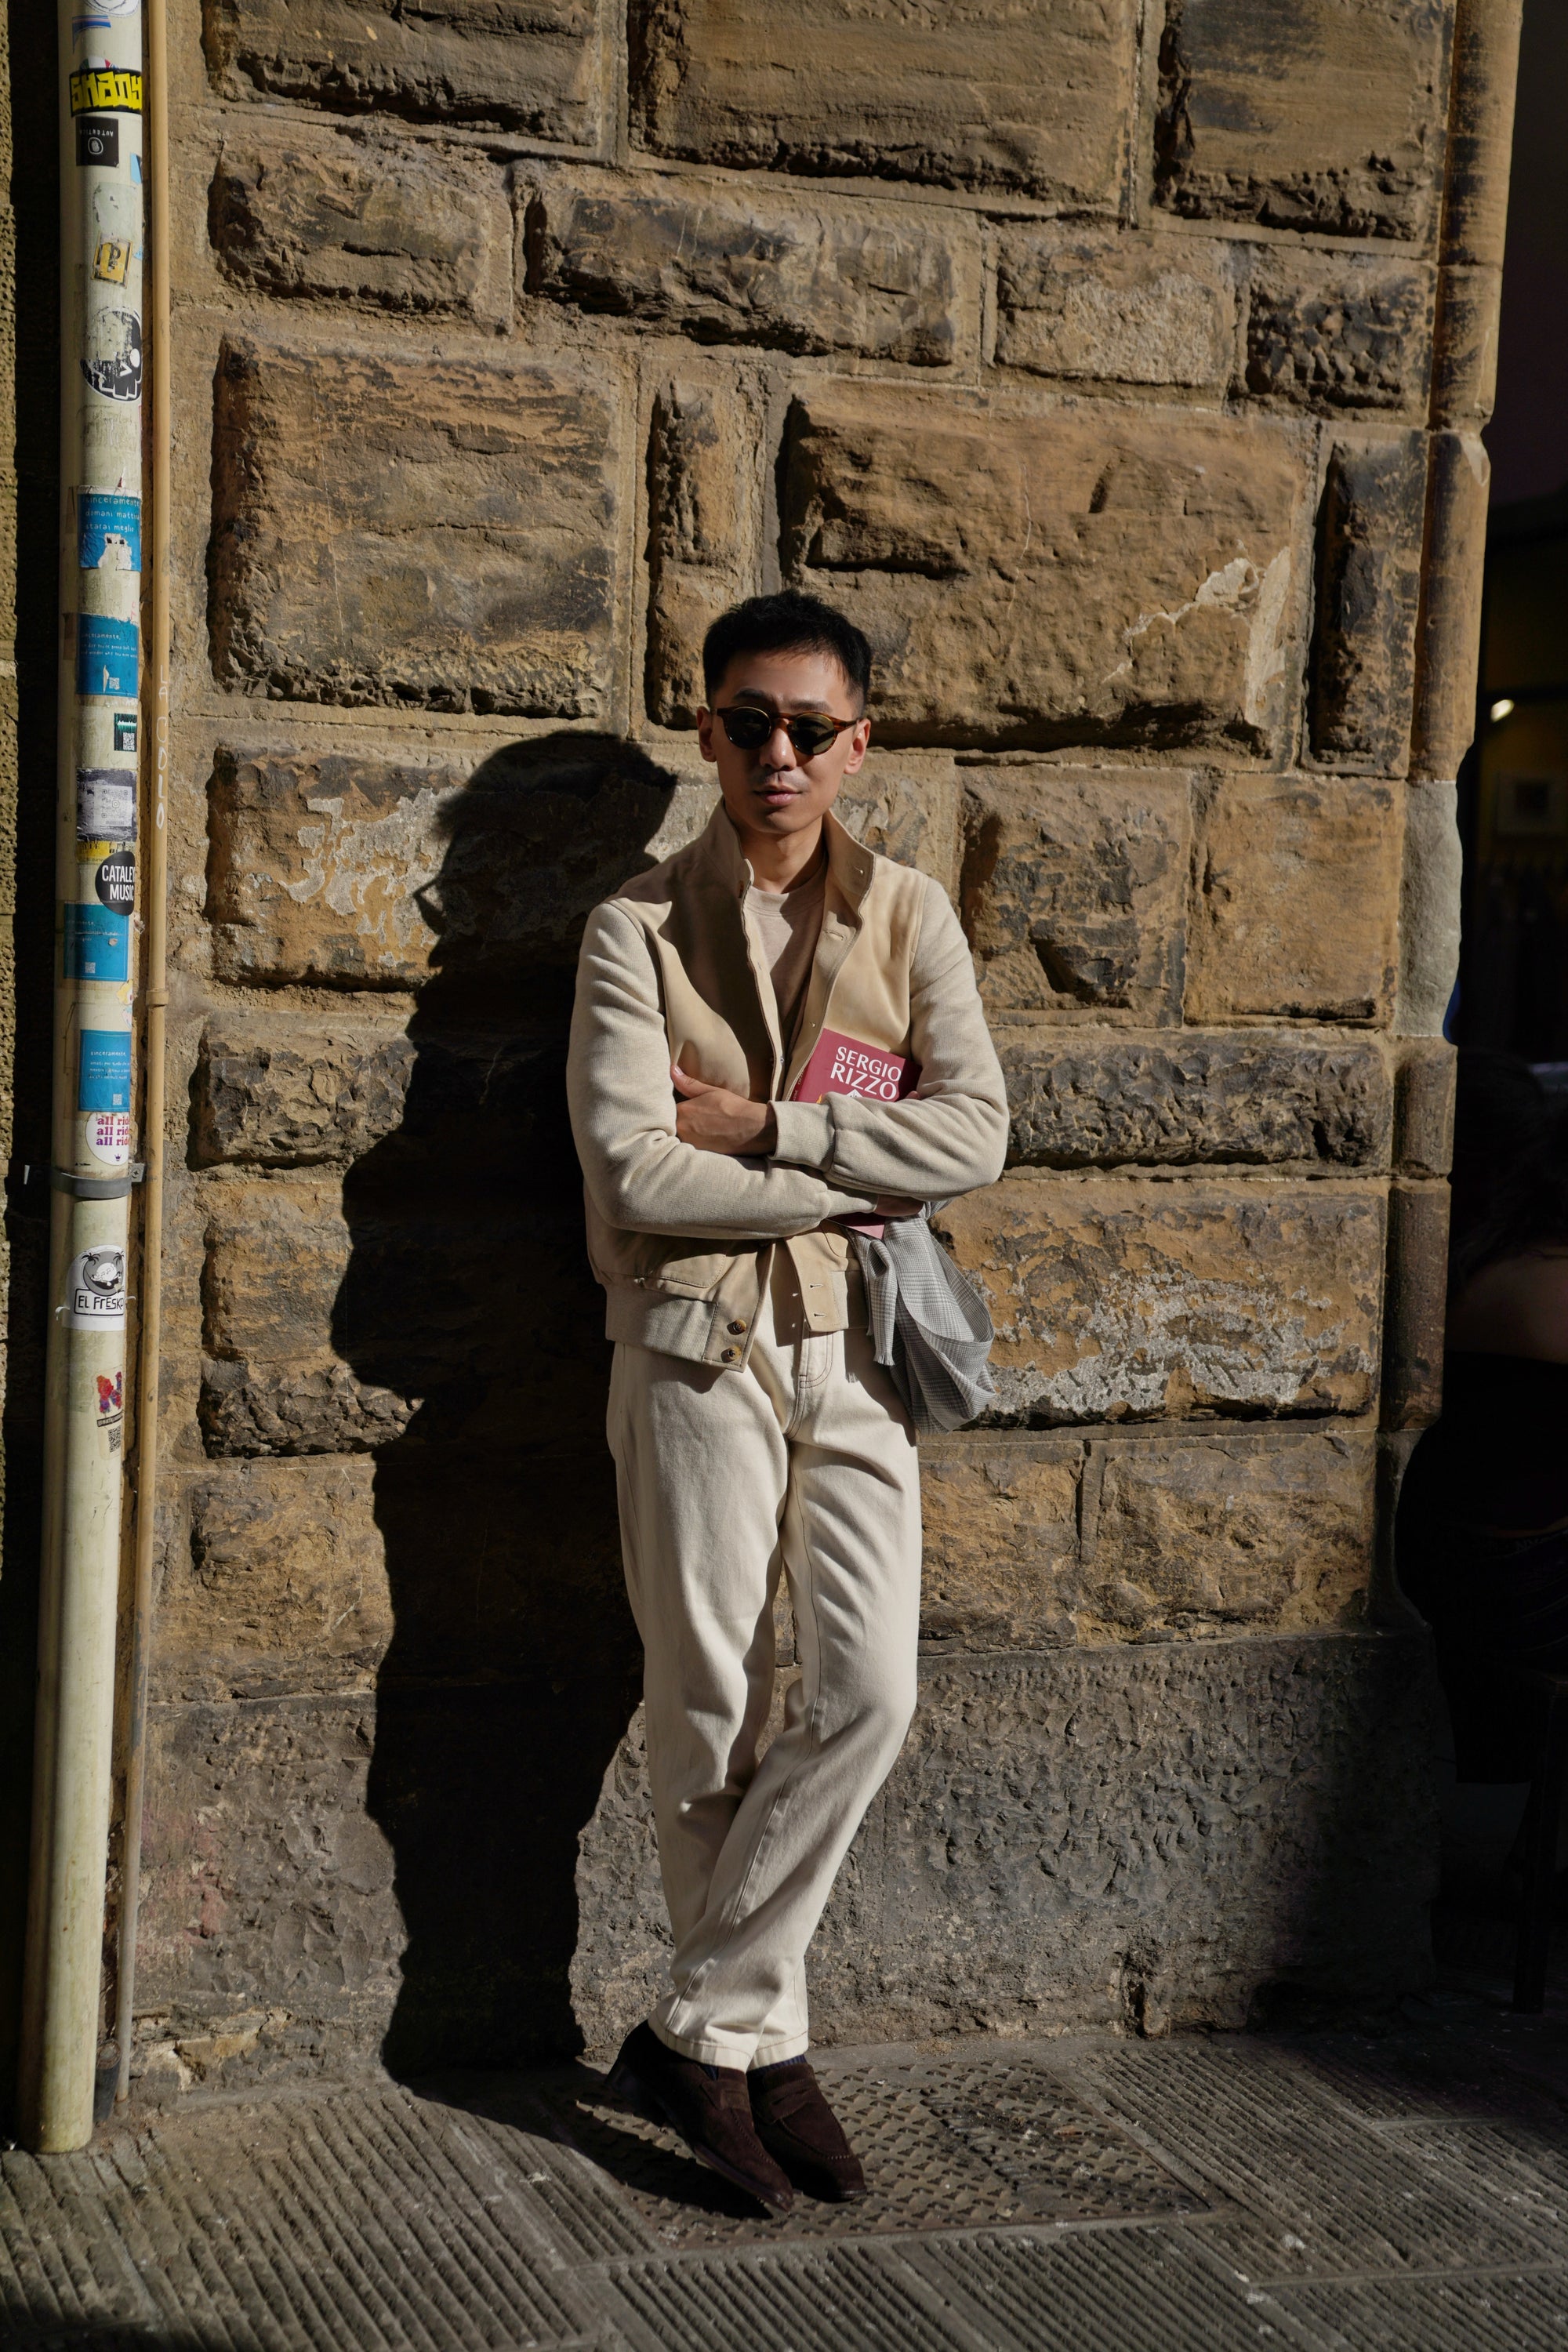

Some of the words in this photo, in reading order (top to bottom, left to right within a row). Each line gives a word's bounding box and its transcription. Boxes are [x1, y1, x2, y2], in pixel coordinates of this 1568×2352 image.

[85, 508, 113, 517] domani
[114, 524, 133, 533] meglio
[110, 884, 134, 902] MUSIC
[836, 1046, 902, 1082] SERGIO
[830, 1062, 897, 1100] RIZZO
[97, 1116, 114, 1125] all
[117, 1116, 129, 1125] rid
[96, 1126, 114, 1135] all
[117, 1126, 129, 1135] rid
[96, 1136, 113, 1145] all
[116, 1136, 129, 1145] rid
[78, 1295, 89, 1308] EL
